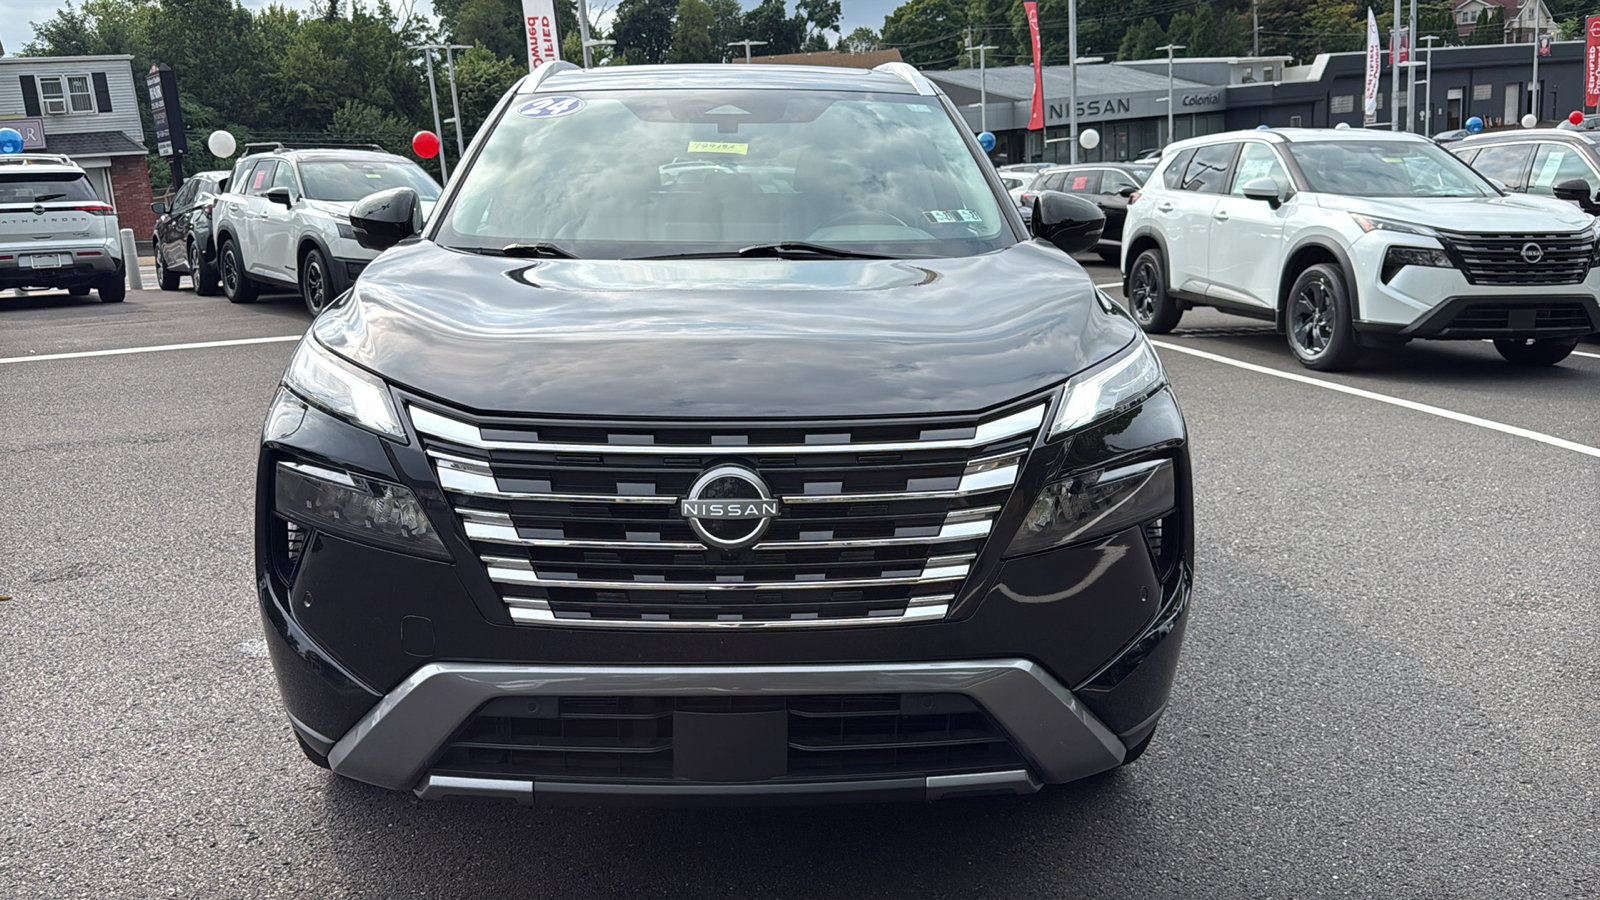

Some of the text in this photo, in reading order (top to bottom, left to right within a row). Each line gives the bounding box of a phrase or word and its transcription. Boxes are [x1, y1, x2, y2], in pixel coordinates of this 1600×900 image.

[520, 97, 581, 116] 24
[1182, 93, 1221, 106] Colonial
[1049, 98, 1130, 120] NISSAN
[684, 503, 776, 516] NISSAN
